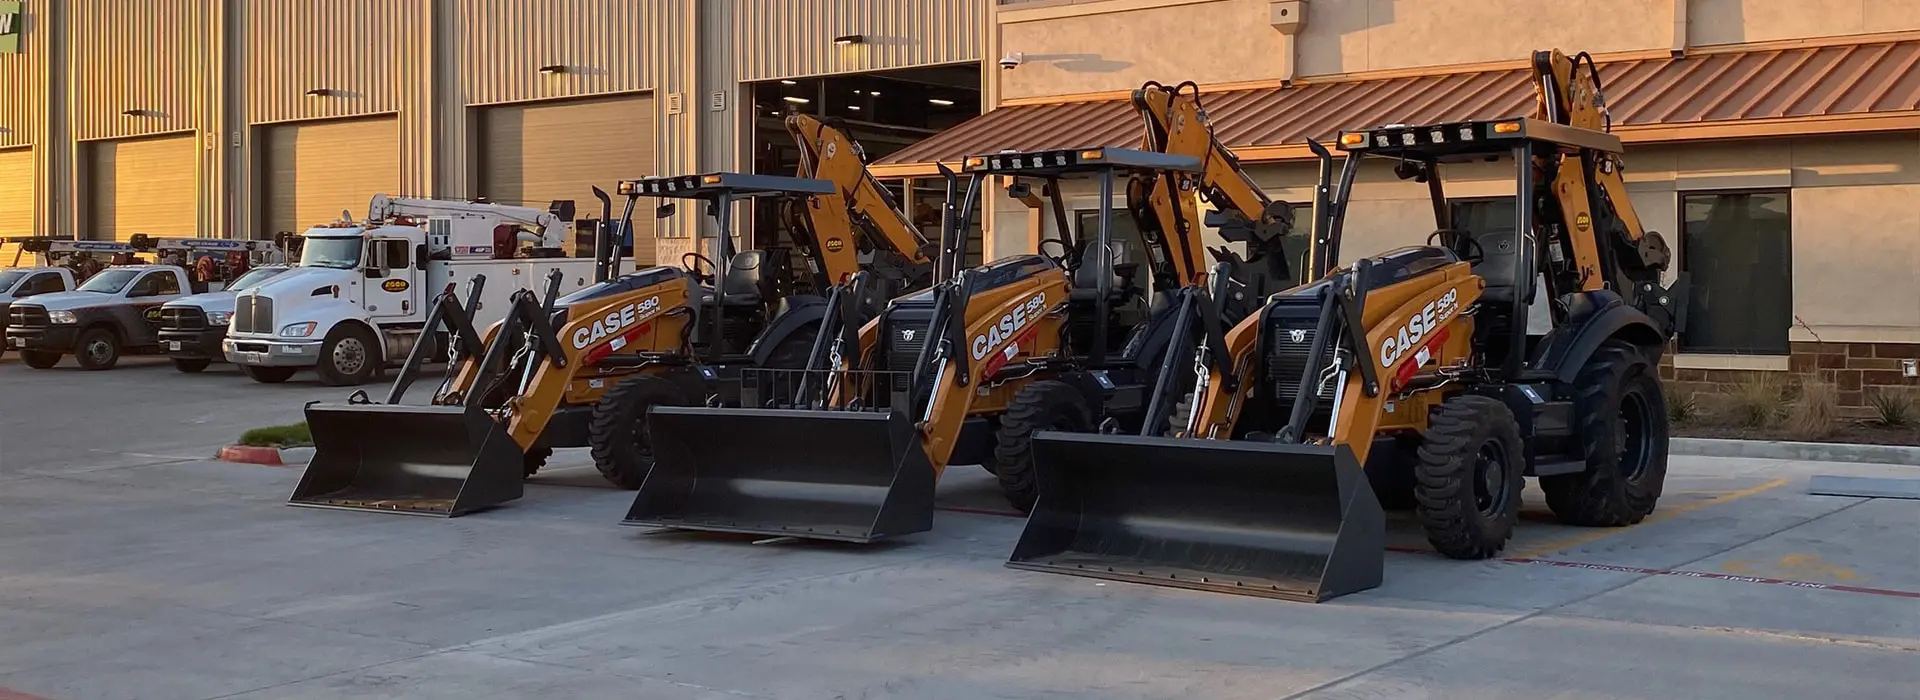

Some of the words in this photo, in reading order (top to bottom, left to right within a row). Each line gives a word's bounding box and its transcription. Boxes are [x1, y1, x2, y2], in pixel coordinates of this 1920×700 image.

[572, 303, 636, 350] CASE
[637, 296, 659, 313] 580
[972, 302, 1027, 361] CASE
[1027, 292, 1045, 313] 580
[1380, 301, 1436, 368] CASE
[1437, 288, 1456, 313] 580
